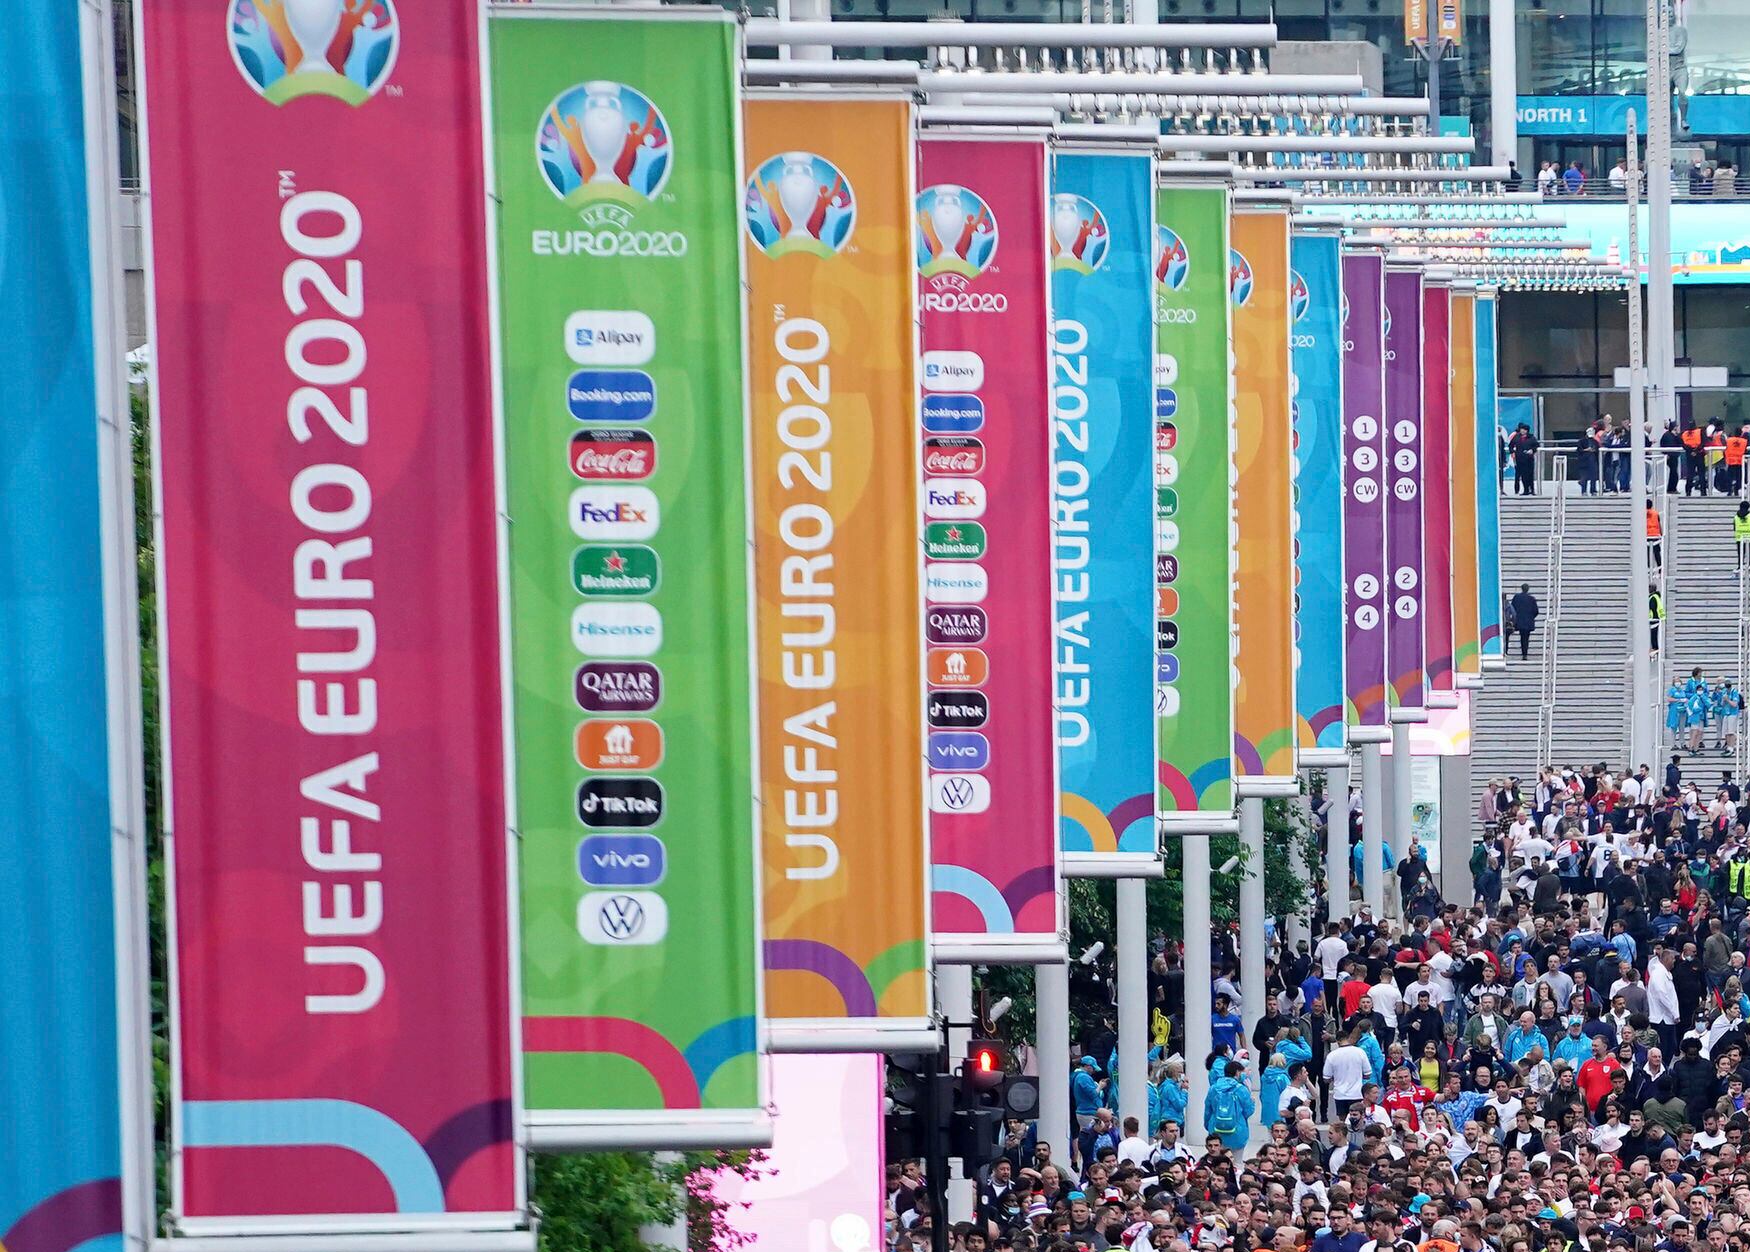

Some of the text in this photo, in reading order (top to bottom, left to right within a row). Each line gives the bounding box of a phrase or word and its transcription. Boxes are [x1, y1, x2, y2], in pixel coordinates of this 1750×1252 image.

[1516, 108, 1587, 123] NORTH 1
[580, 205, 631, 228] UEFA
[532, 229, 688, 257] EURO2020
[280, 190, 369, 447] 2020
[597, 329, 643, 347] Alipay
[941, 365, 976, 378] Alipay
[570, 388, 652, 405] Booking.com
[774, 316, 832, 492] 2020
[924, 407, 981, 421] Booking.com
[1361, 422, 1369, 434] 1
[1402, 426, 1409, 437] 1
[1361, 453, 1370, 465] 3
[1401, 455, 1409, 466] 3
[1355, 484, 1376, 495] CW
[1396, 484, 1414, 494] CW
[929, 490, 976, 506] FedEx
[581, 502, 647, 523] FedEx
[1056, 459, 1091, 603] EURO
[929, 542, 980, 554] Heineken
[581, 574, 651, 589] Heineken
[928, 577, 983, 589] Hisense
[1402, 573, 1410, 584] 2
[1362, 581, 1371, 592] 2
[289, 463, 380, 735] EURO
[780, 502, 837, 690] EURO
[1402, 602, 1410, 613] 4
[929, 614, 981, 632] QATAR
[1362, 611, 1371, 623] 4
[578, 622, 656, 636] Hisense
[582, 671, 653, 694] QATAR
[1056, 609, 1091, 747] UEFA
[943, 705, 984, 719] TikTok
[937, 744, 979, 757] vivo
[784, 700, 840, 881] UEFA
[600, 796, 659, 813] TikTok
[593, 850, 650, 868] vivo
[301, 751, 386, 1015] UEFA
